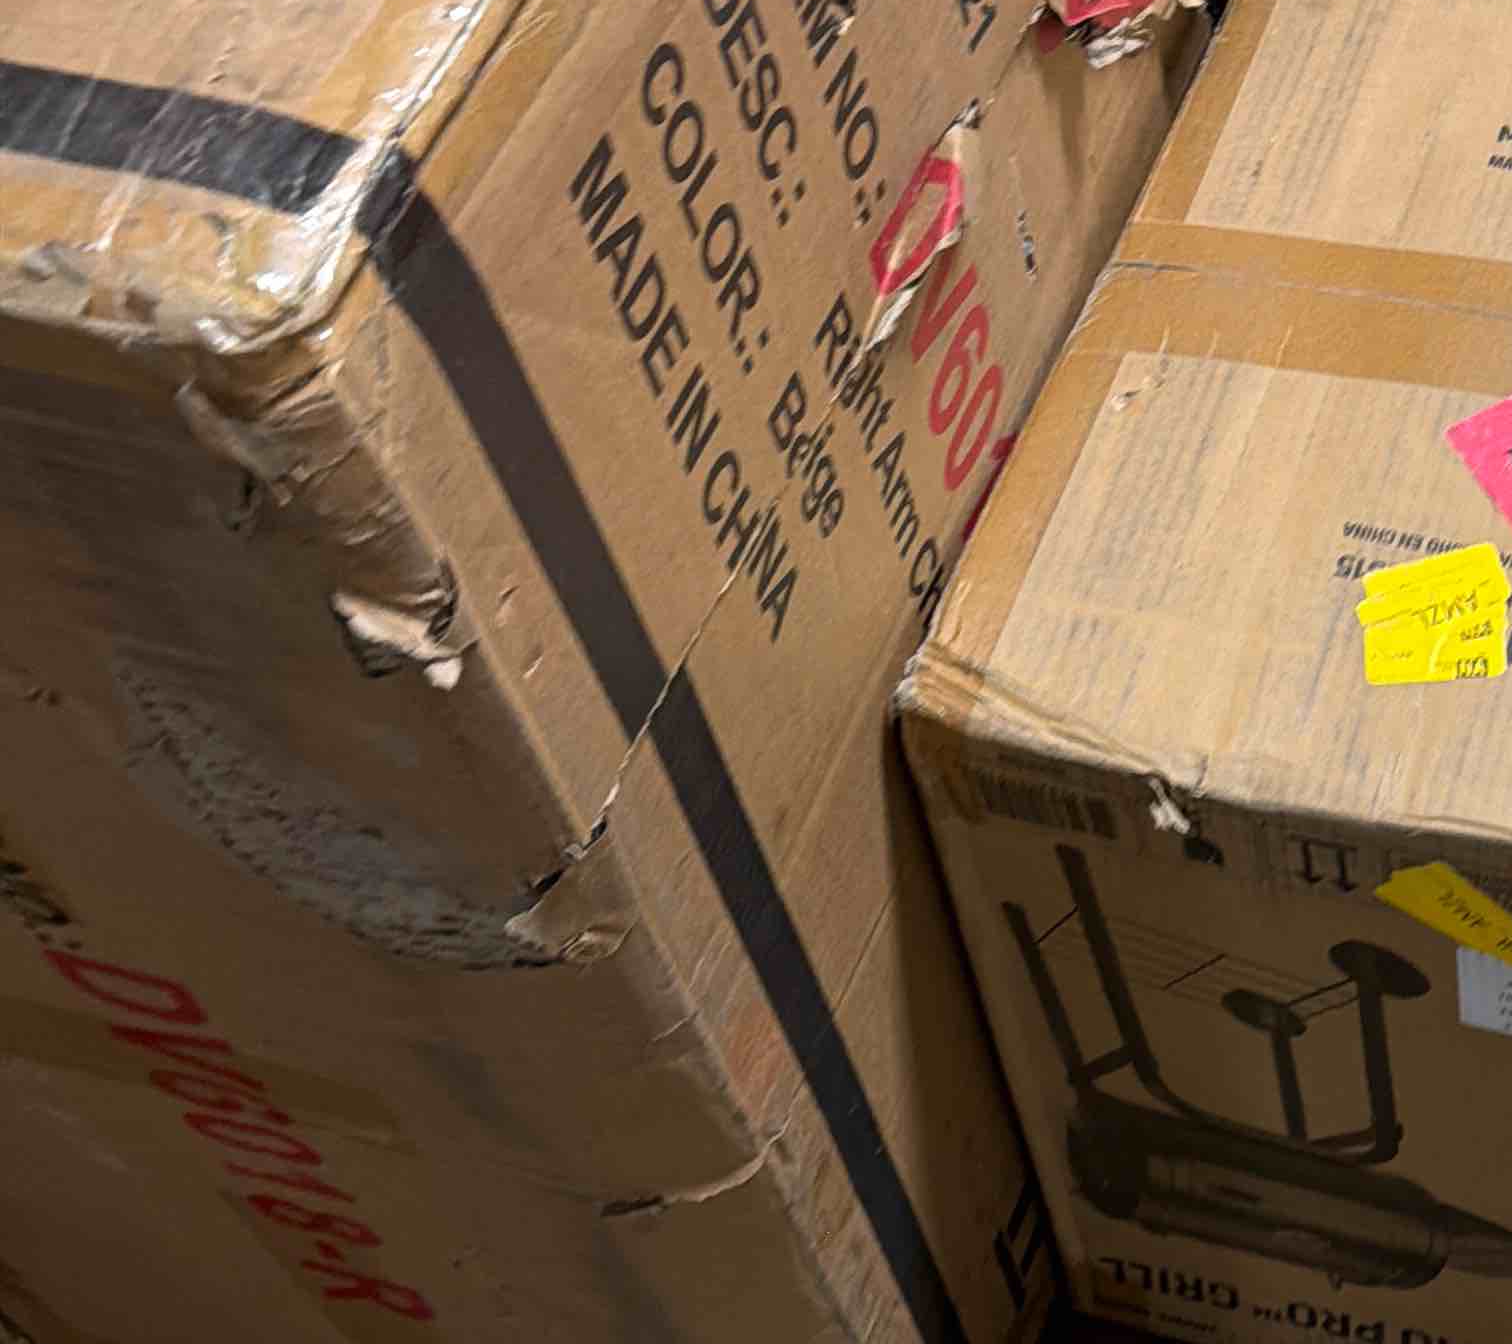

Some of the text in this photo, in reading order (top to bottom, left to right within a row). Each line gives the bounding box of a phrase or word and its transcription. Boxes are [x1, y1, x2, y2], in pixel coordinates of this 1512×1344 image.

[567, 131, 798, 643] MADE IN CHINA
[871, 432, 921, 560] Arm
[1100, 1257, 1241, 1315] GRILL
